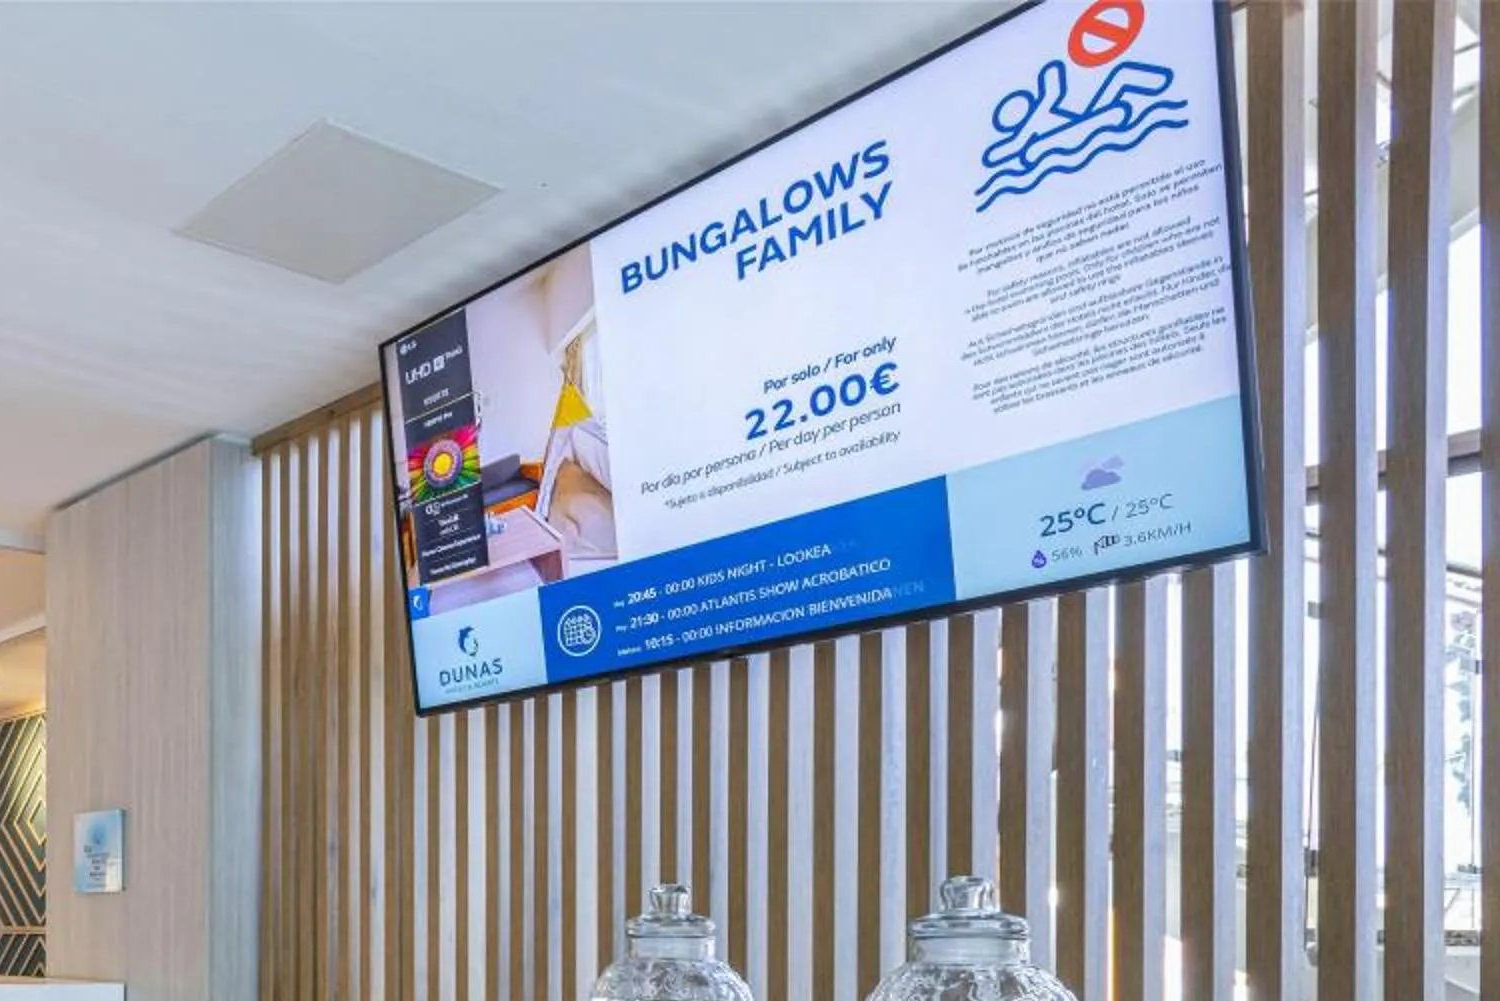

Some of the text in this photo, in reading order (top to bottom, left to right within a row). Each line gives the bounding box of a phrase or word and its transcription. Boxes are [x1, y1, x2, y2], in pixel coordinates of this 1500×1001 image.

[621, 140, 889, 294] BUNGALOWS
[736, 181, 892, 280] FAMILY
[764, 377, 788, 394] Por
[791, 365, 820, 384] solo
[835, 350, 860, 368] For
[862, 336, 896, 358] only
[745, 362, 900, 440] 22.00€
[641, 481, 660, 495] Por
[683, 467, 702, 485] por
[705, 450, 756, 478] persona
[769, 438, 792, 453] Per
[793, 428, 821, 446] day
[823, 419, 847, 439] per
[849, 403, 901, 432] person
[783, 454, 822, 474] Subject
[825, 451, 837, 461] to
[838, 431, 900, 457] availability
[1052, 521, 1191, 562] 56% 3.6KM/H
[628, 587, 657, 604] 20:45
[665, 577, 695, 595] 00:00
[697, 570, 725, 586] KIDS
[727, 560, 766, 579] NIGHT
[777, 544, 832, 567] LOOKEA
[630, 612, 659, 628] 21:30
[667, 603, 699, 620] 00:00
[700, 589, 756, 612] ATLANTIS
[759, 579, 799, 599] SHOW
[802, 558, 891, 589] ACROBATICO
[645, 634, 674, 649] 10:15
[681, 625, 713, 643] 00:00
[715, 606, 805, 634] INFORMACION
[809, 588, 892, 616] BIENVENIDA
[439, 658, 503, 687] DUNAS
